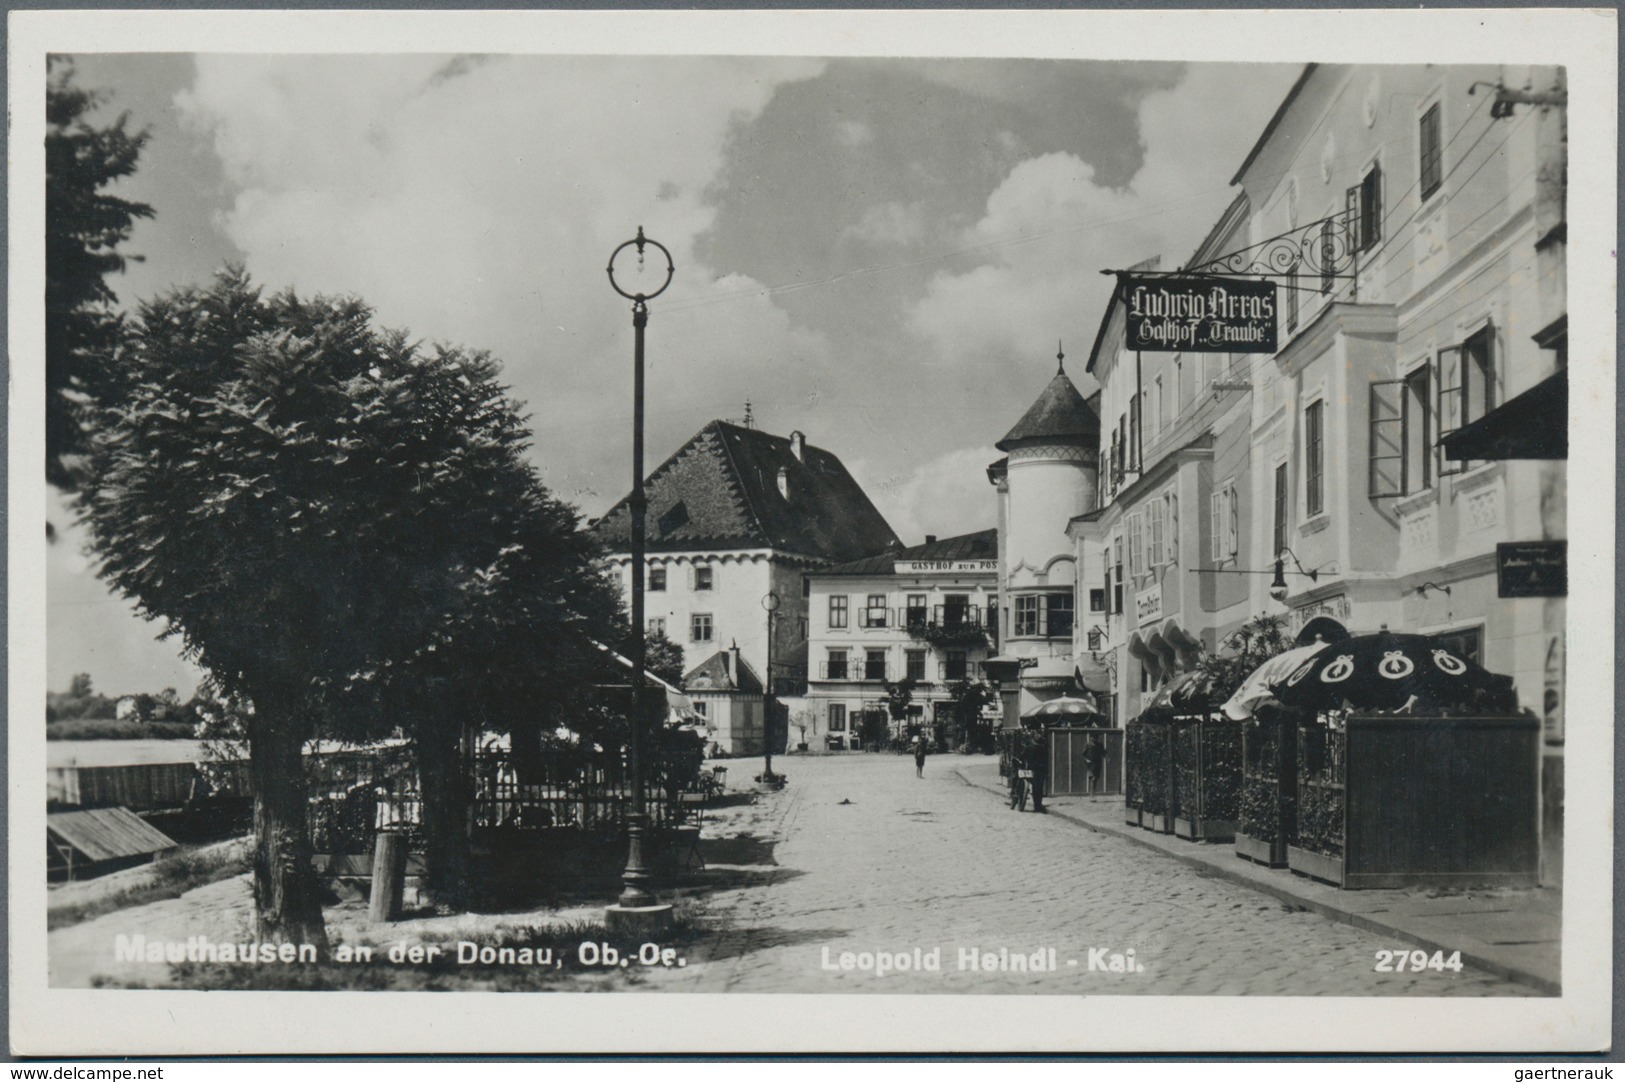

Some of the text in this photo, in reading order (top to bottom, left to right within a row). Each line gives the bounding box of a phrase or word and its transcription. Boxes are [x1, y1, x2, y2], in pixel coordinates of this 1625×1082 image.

[1129, 286, 1205, 319] Ludwig
[1137, 318, 1200, 348] Gasthof
[911, 561, 954, 570] GASTHOF
